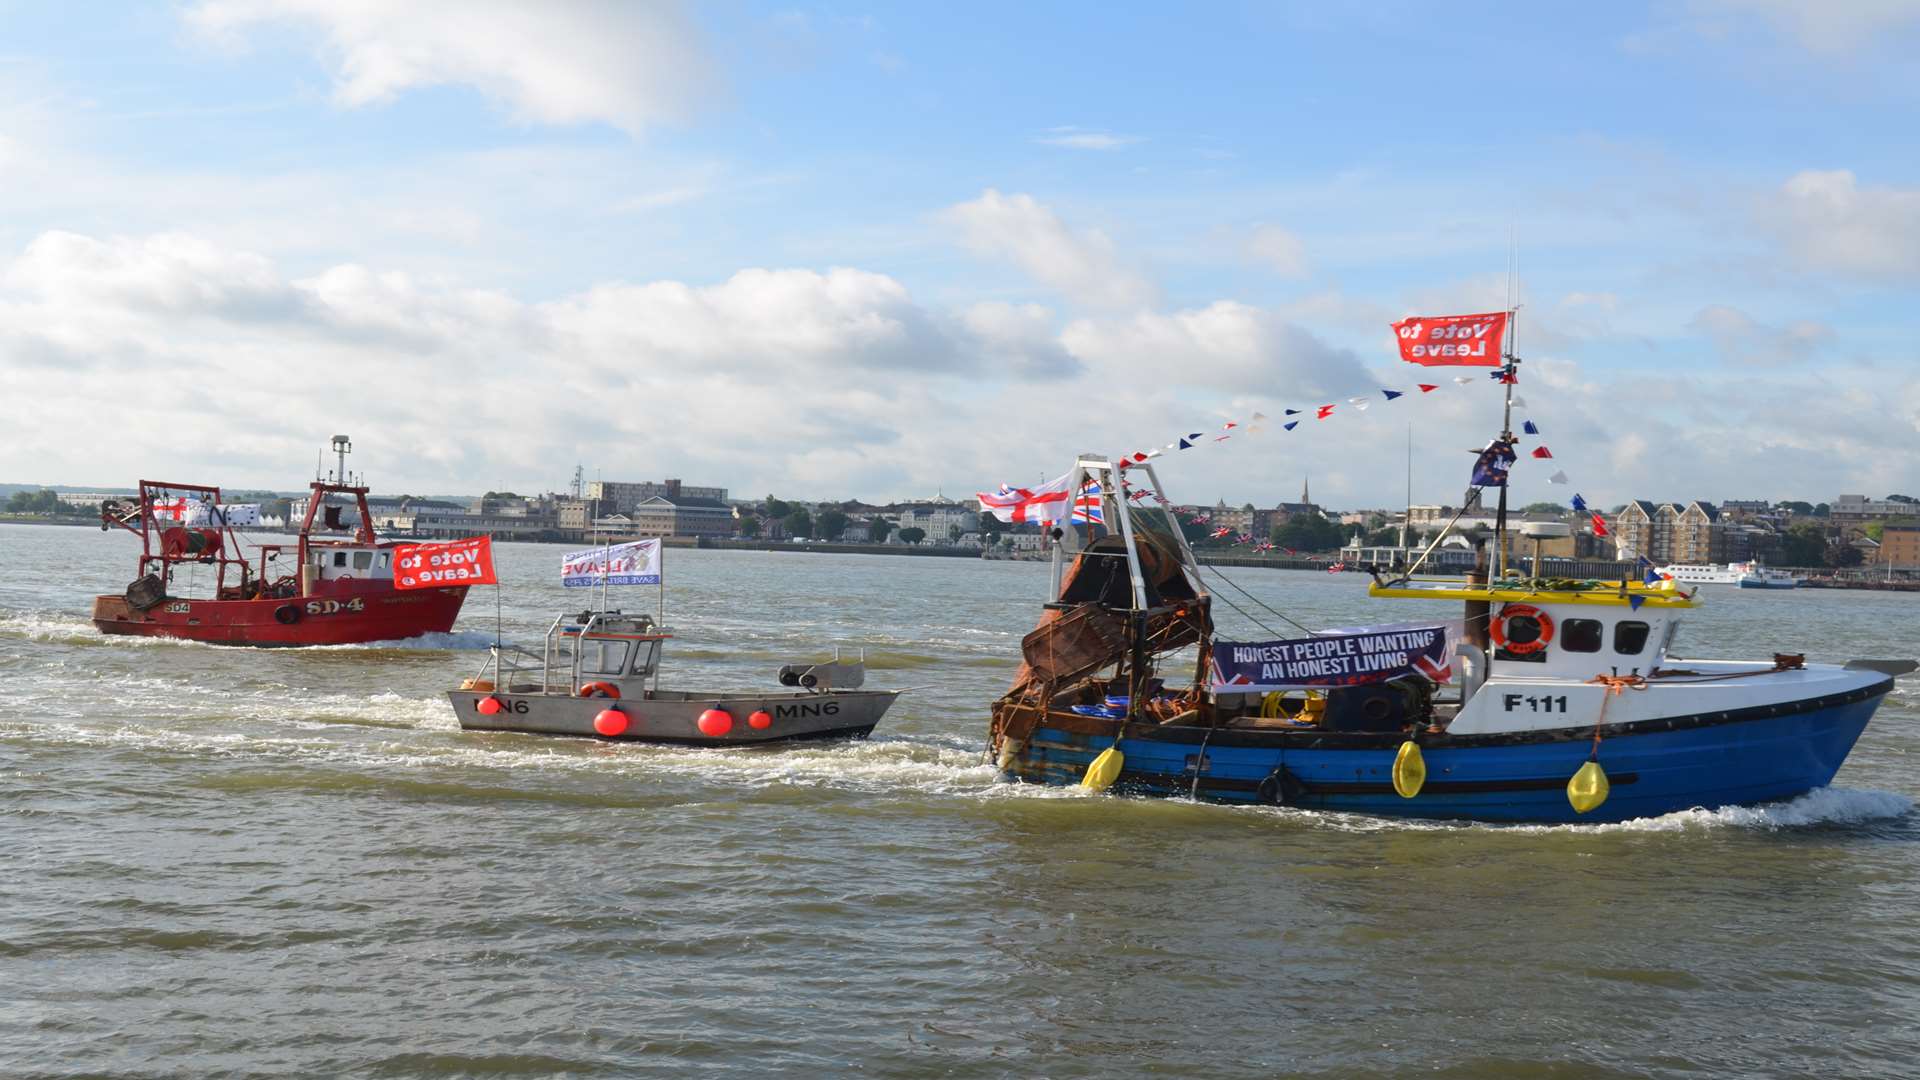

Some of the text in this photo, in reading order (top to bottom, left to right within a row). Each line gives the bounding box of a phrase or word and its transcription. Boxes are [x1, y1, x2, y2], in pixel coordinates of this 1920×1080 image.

[1233, 645, 1289, 663] HONEST
[1294, 638, 1355, 660] PEOPLE
[1359, 631, 1435, 654] WANTING
[1262, 663, 1285, 679] AN
[1287, 657, 1350, 678] HONEST
[1355, 651, 1408, 672] LIVING
[473, 699, 529, 714] N6
[776, 702, 840, 718] MN6
[1504, 694, 1567, 713] F111
